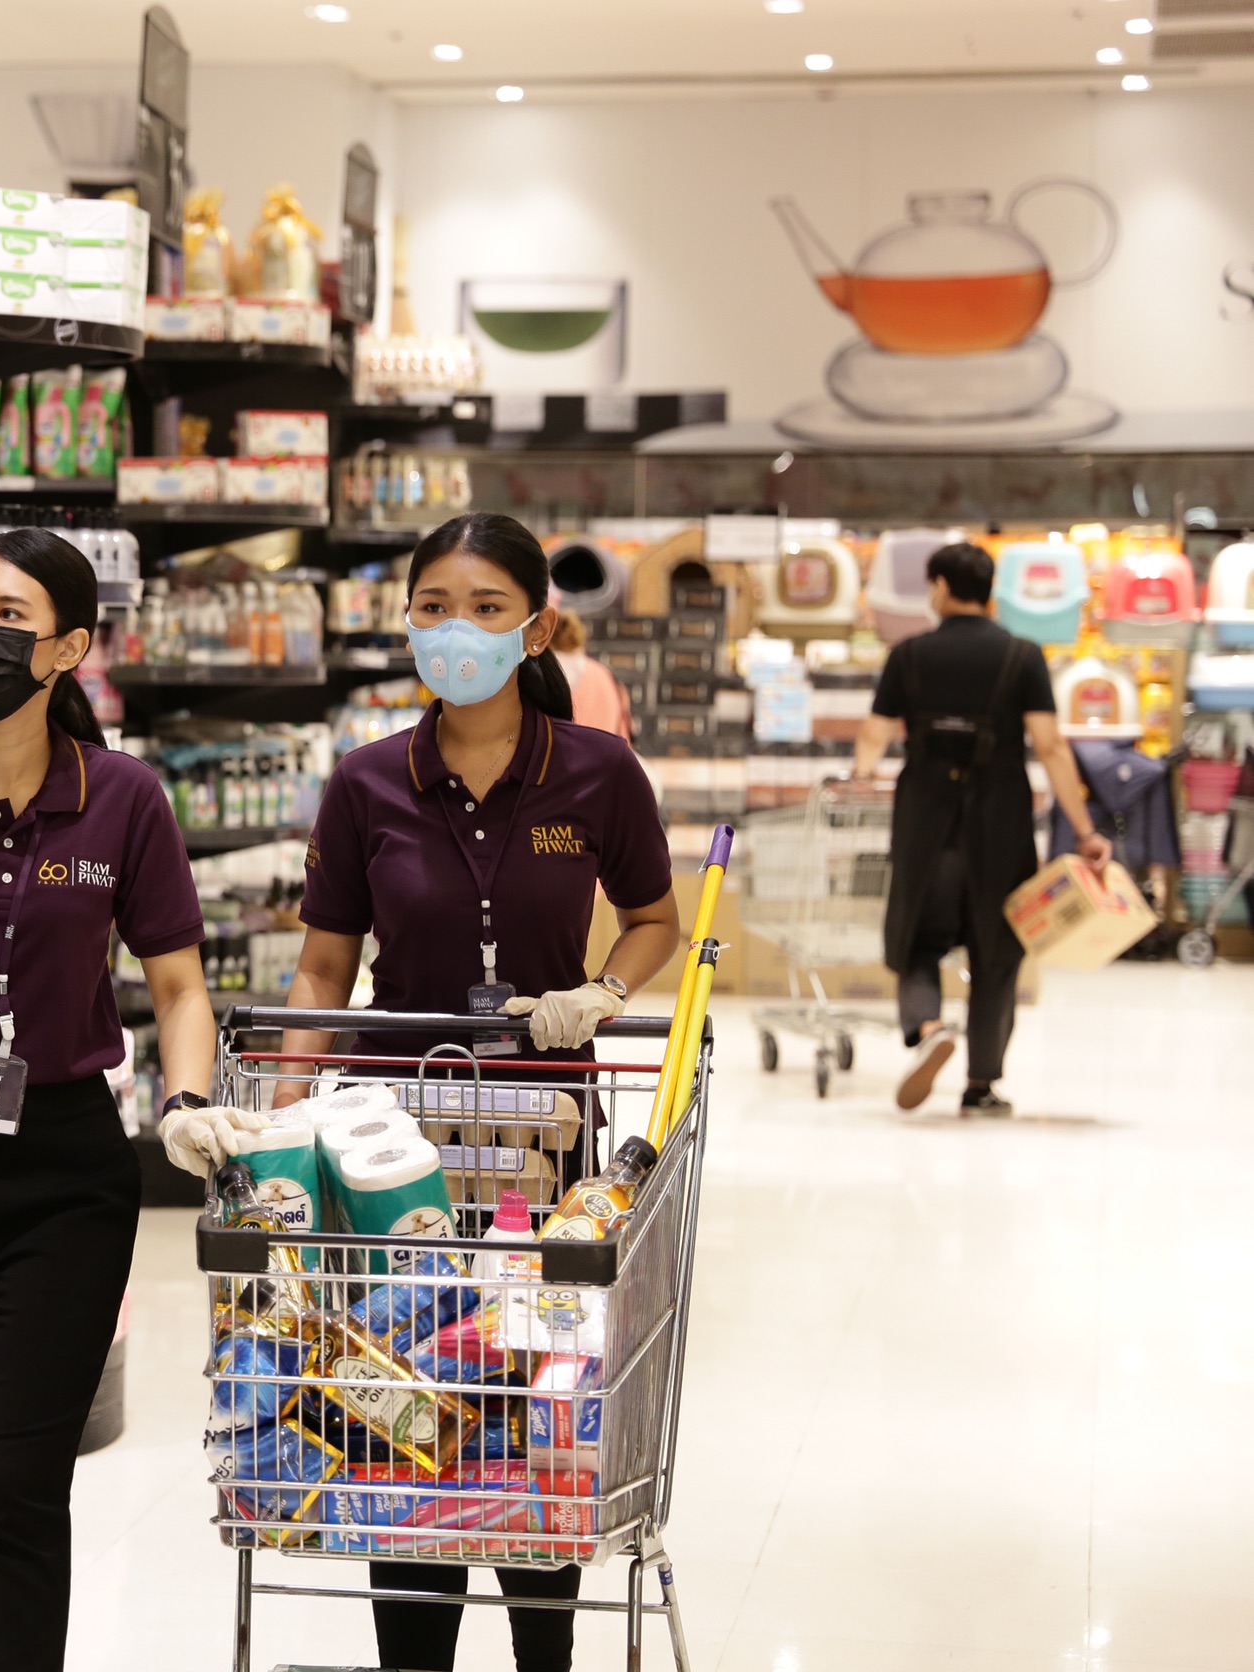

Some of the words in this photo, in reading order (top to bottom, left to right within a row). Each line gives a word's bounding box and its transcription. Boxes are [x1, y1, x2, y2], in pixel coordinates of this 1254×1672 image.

[531, 825, 572, 841] SIAM
[533, 839, 583, 854] PIWAT
[39, 859, 68, 880] 60
[78, 860, 110, 875] SIAM
[78, 871, 116, 888] PIWAT
[531, 1407, 547, 1437] Ziploc
